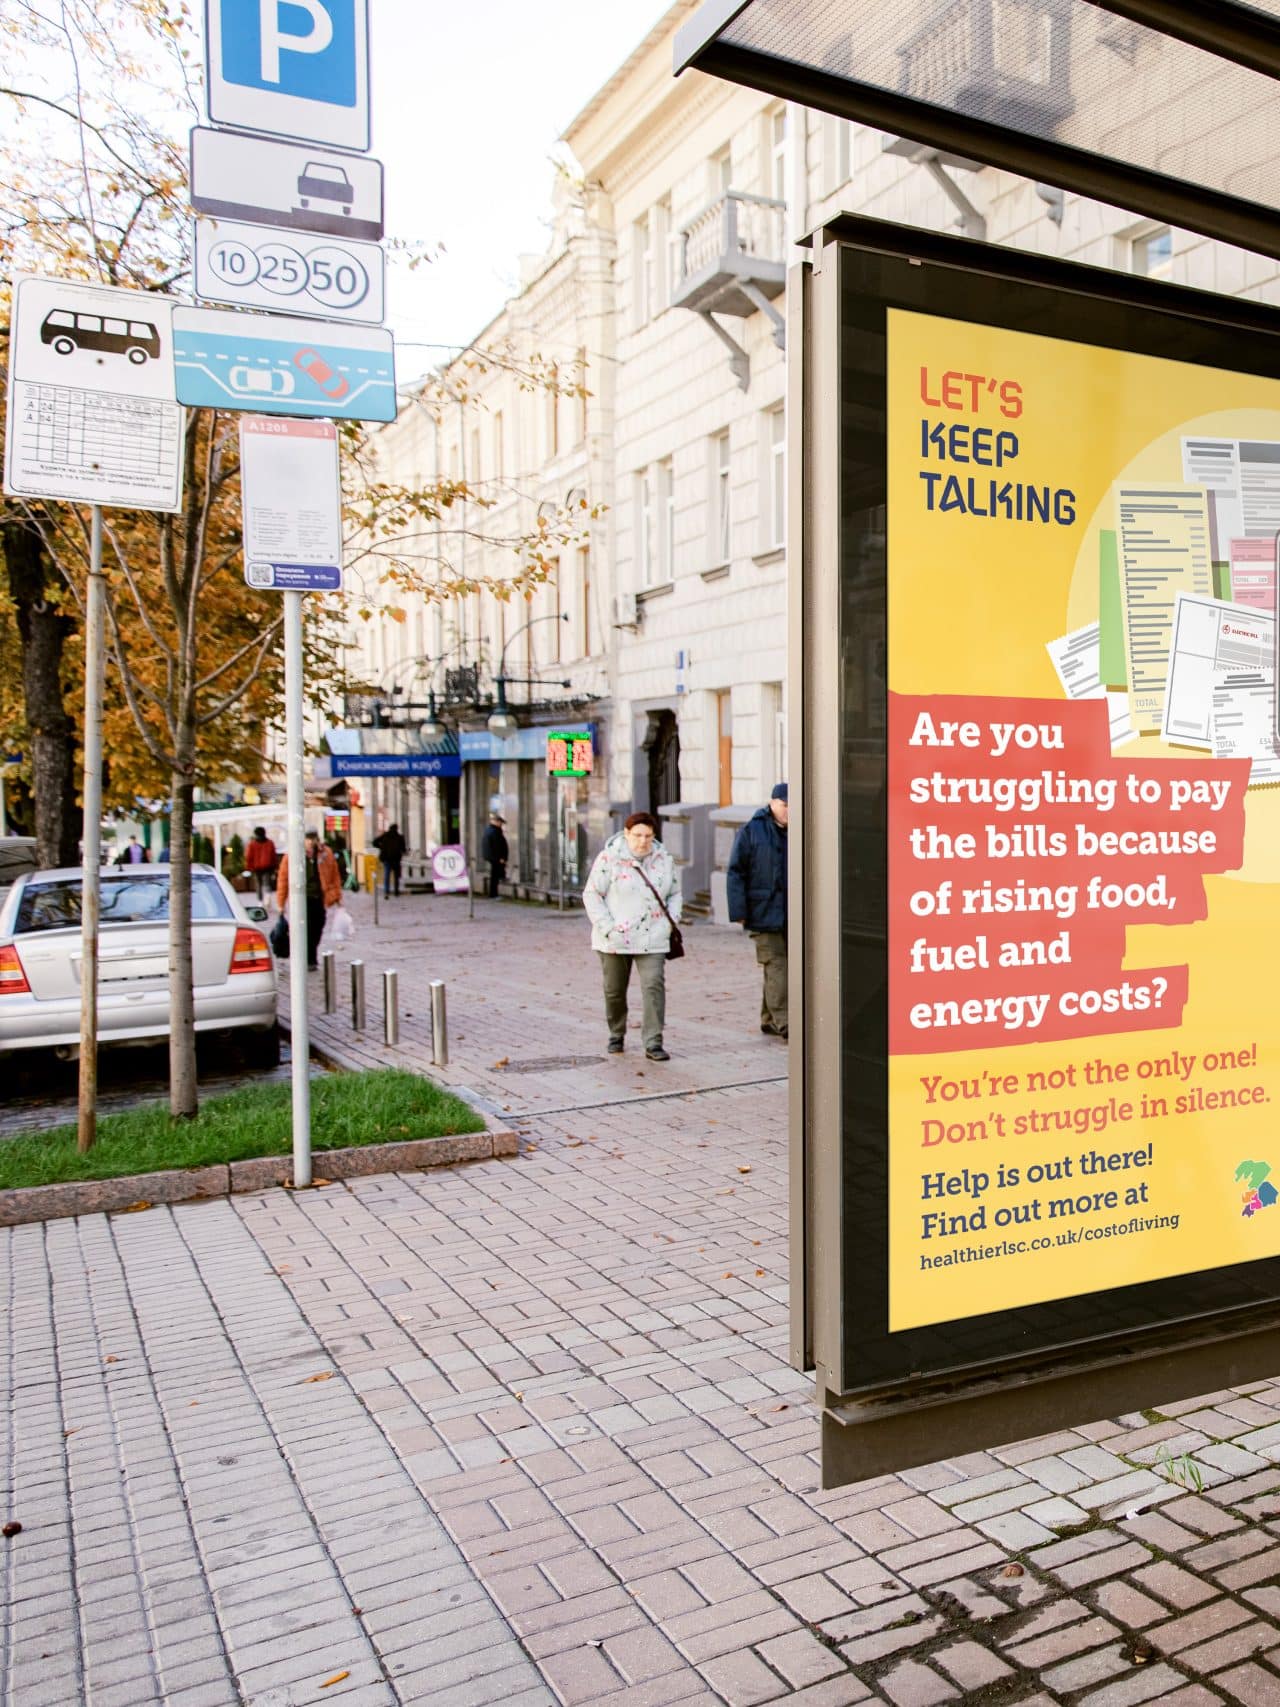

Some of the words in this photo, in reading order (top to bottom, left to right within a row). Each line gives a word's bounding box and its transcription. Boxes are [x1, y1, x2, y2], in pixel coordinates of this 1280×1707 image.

[261, 0, 333, 84] P
[218, 250, 246, 274] 10
[261, 256, 298, 283] 25
[312, 260, 357, 295] 50
[921, 367, 1022, 418] LET'S
[922, 420, 1018, 467] KEEP
[920, 472, 1075, 525] TALKING
[1135, 698, 1158, 708] TOTAL
[909, 712, 980, 747] Are
[990, 724, 1064, 756] you
[1216, 741, 1236, 749] TOTAL
[910, 771, 1117, 811] struggling
[1126, 774, 1161, 803] to
[1170, 780, 1231, 811] pay
[910, 826, 976, 859] the
[985, 825, 1067, 858] bills
[1075, 824, 1216, 856] because
[910, 881, 952, 916] of
[963, 880, 1078, 918] rising
[1087, 875, 1176, 909] food,
[911, 936, 989, 972] fuel
[999, 932, 1071, 967] and
[910, 994, 1050, 1029] energy
[1059, 977, 1167, 1016] costs?
[920, 1071, 1018, 1104] You're
[1027, 1064, 1076, 1092] not
[1084, 1059, 1129, 1085] the
[1136, 1051, 1196, 1081] only
[1203, 1043, 1256, 1071] one!
[921, 1112, 1006, 1147] Don't
[1014, 1098, 1133, 1135] struggle
[1141, 1094, 1168, 1118] in
[1175, 1087, 1270, 1114] silence.
[922, 1169, 989, 1199] Help
[997, 1164, 1019, 1188] is
[1027, 1157, 1072, 1183] out
[1079, 1143, 1152, 1175] there!
[921, 1206, 987, 1239] Find
[995, 1200, 1041, 1226] out
[1049, 1192, 1117, 1218] more
[1125, 1183, 1148, 1205] at
[920, 1212, 1180, 1271] healthierlsc.co.uk/costofliving
